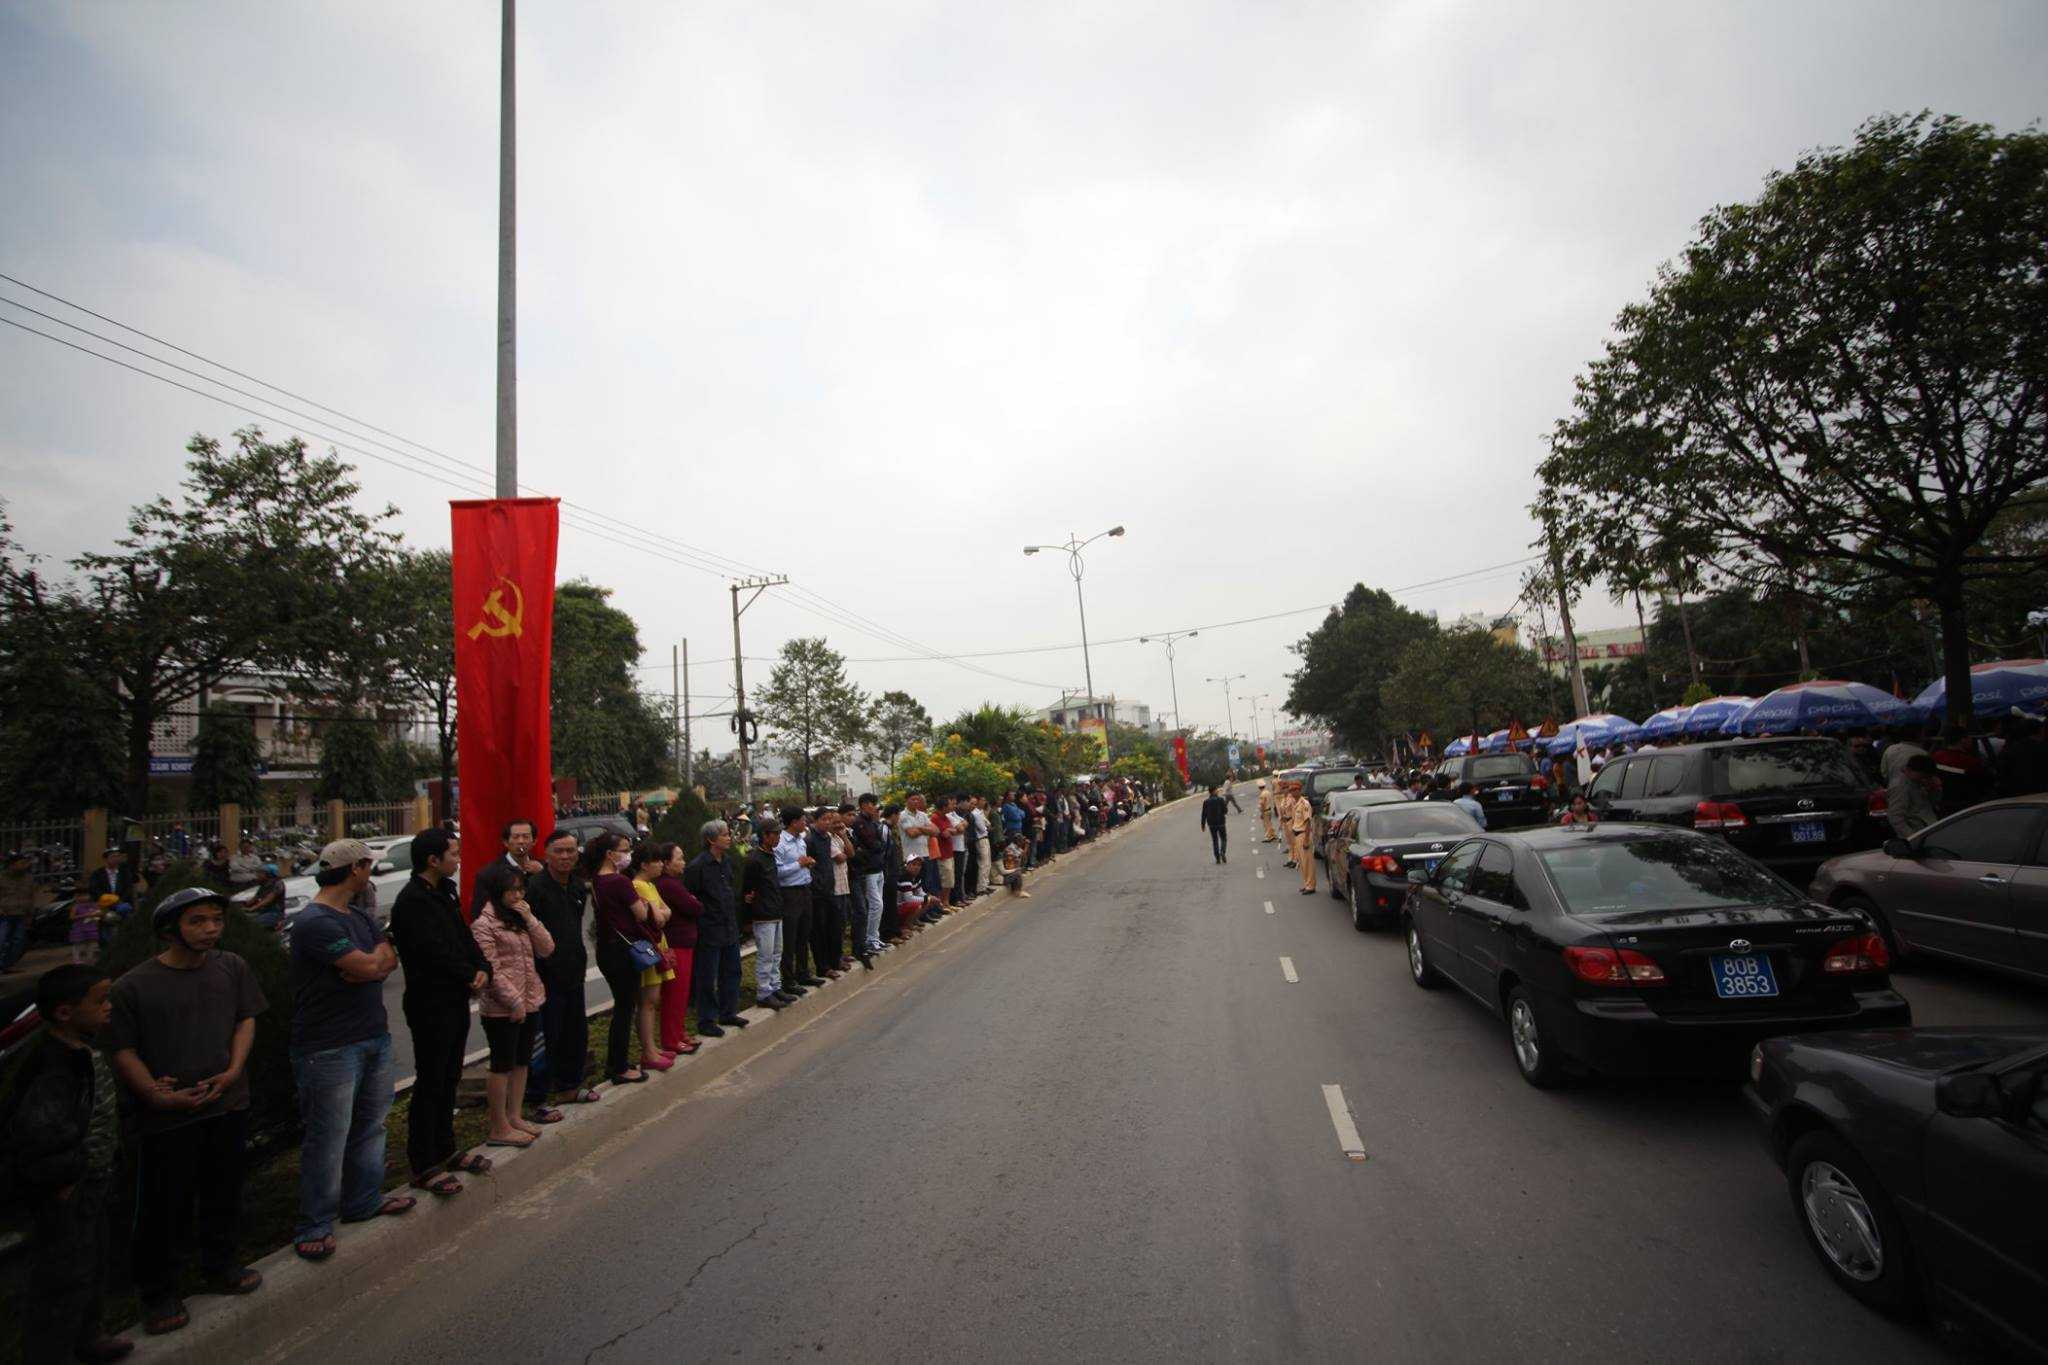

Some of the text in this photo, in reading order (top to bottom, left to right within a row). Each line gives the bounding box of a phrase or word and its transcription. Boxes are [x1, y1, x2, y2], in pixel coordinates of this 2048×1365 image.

[1807, 703, 1857, 715] pepsi
[1723, 958, 1759, 976] 80B
[1722, 976, 1770, 994] 3853
